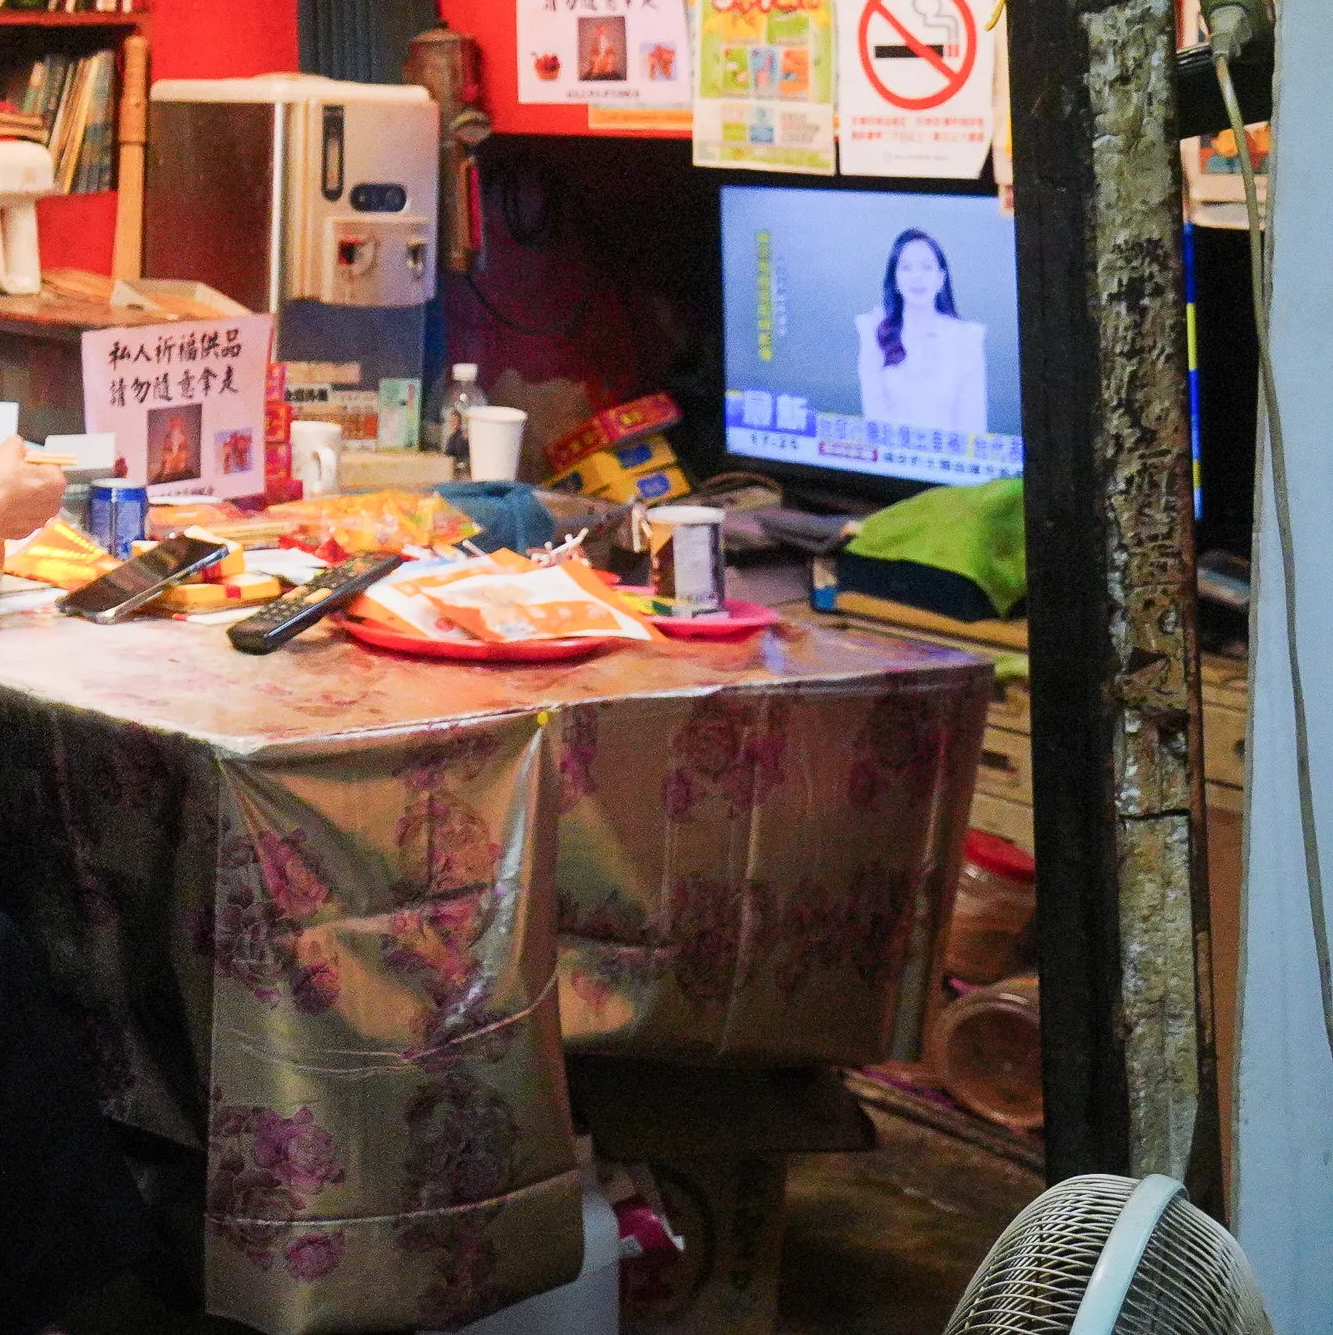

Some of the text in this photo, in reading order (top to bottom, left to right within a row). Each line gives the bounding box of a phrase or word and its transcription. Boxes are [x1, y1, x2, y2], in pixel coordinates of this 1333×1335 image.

[108, 328, 243, 370] 私人祈福供品
[109, 365, 239, 408] 請勿隨意拿走
